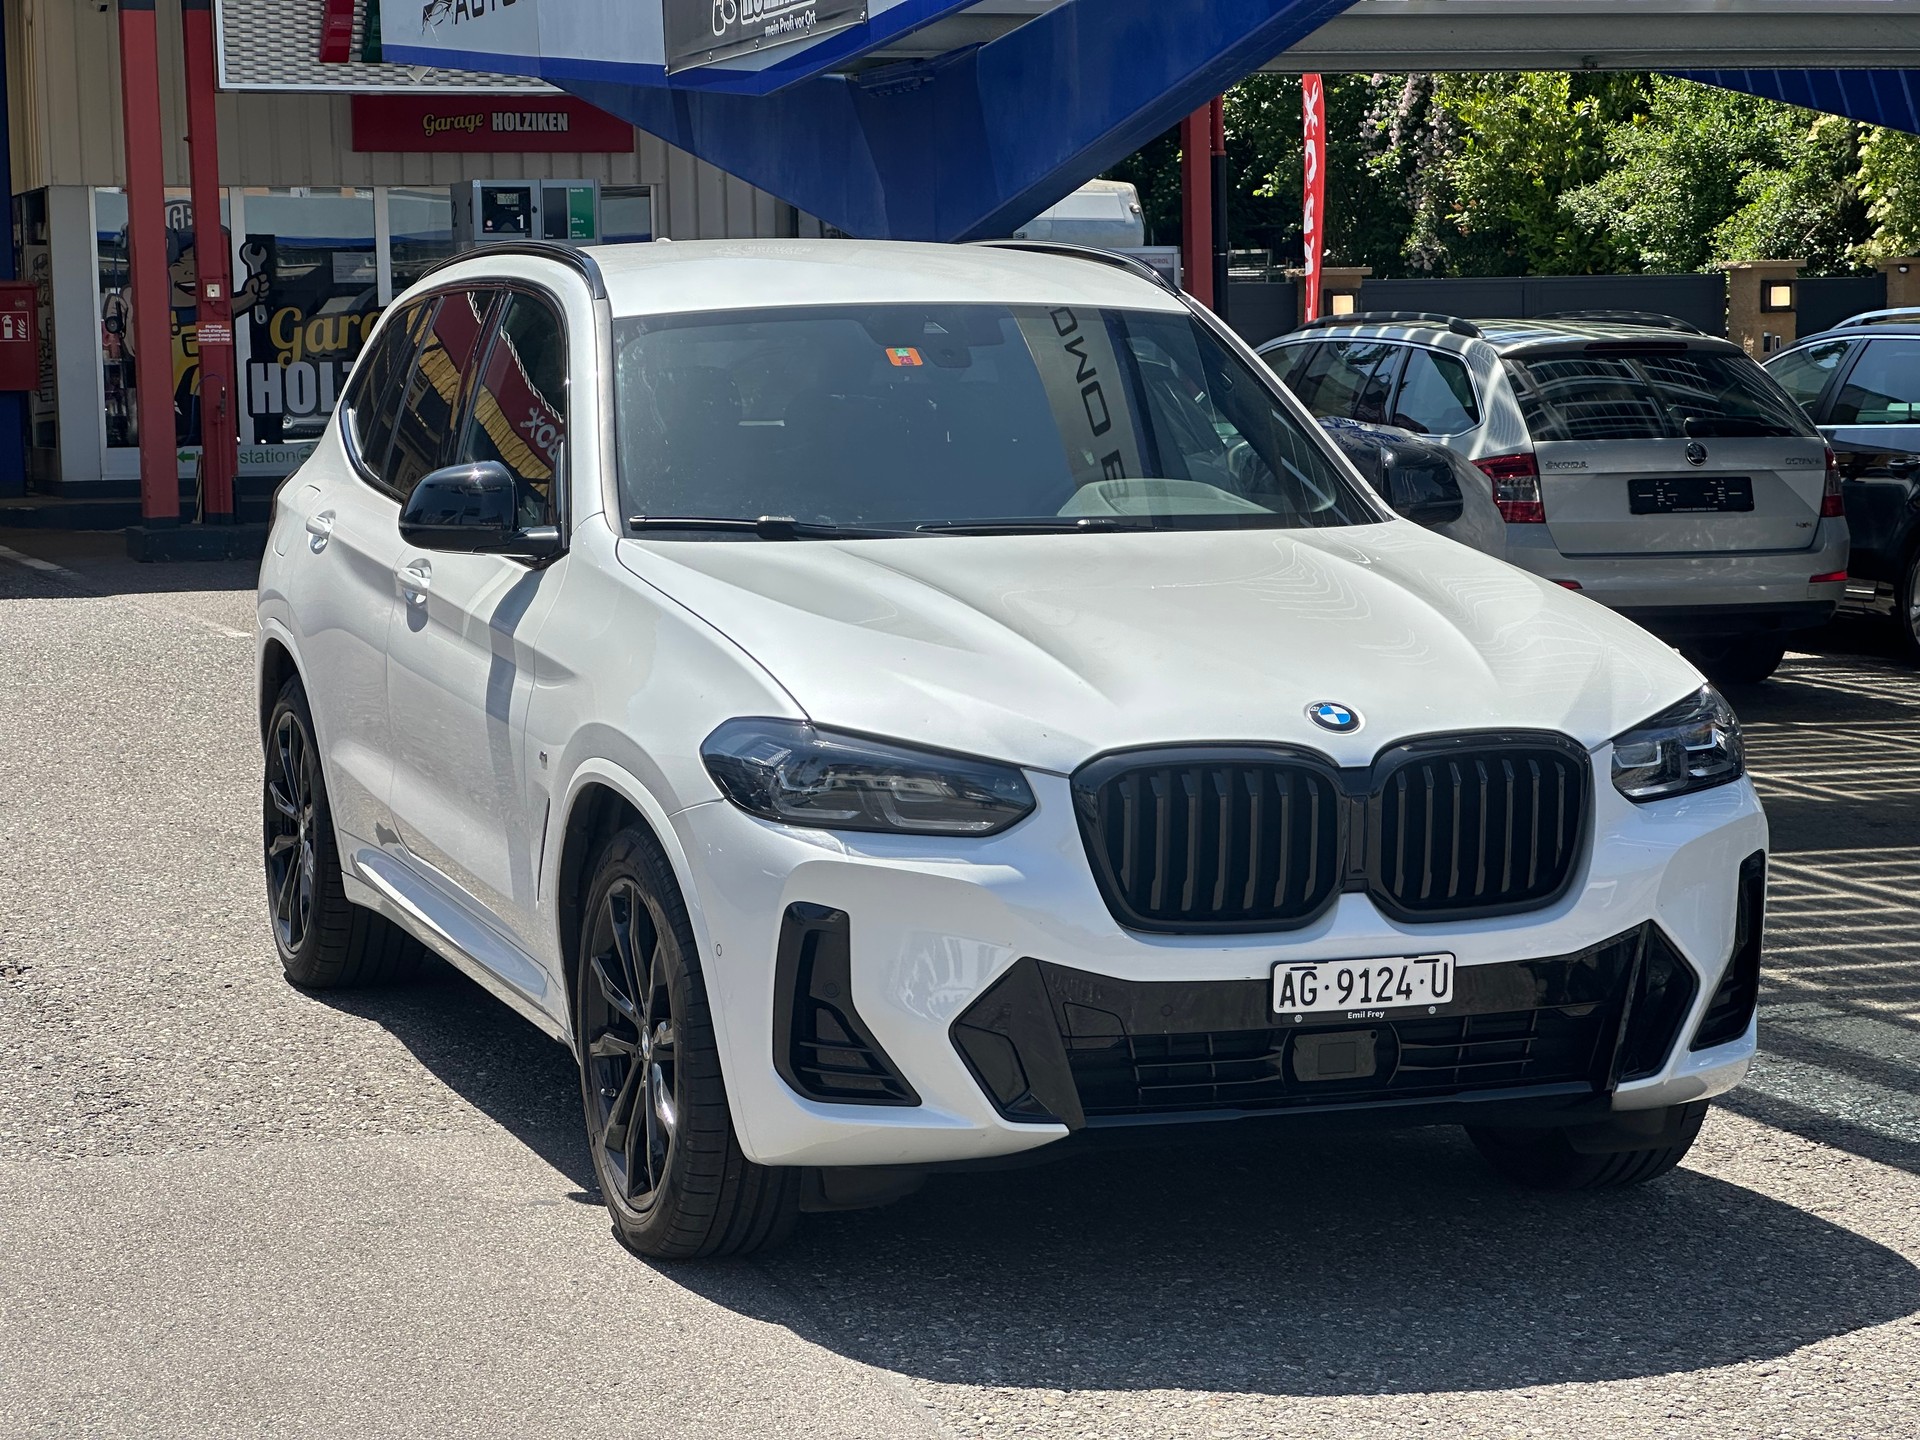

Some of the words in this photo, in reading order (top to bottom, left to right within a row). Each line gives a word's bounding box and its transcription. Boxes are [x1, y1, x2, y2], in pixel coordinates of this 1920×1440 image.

[765, 22, 780, 37] mein
[780, 15, 794, 33] Profi
[794, 17, 805, 30] vor
[805, 9, 817, 27] Ort
[422, 113, 484, 137] Garage
[491, 112, 569, 132] HOLZIKEN
[516, 214, 525, 229] 1
[1347, 1010, 1365, 1019] Emil
[1366, 1010, 1385, 1019] Frey
